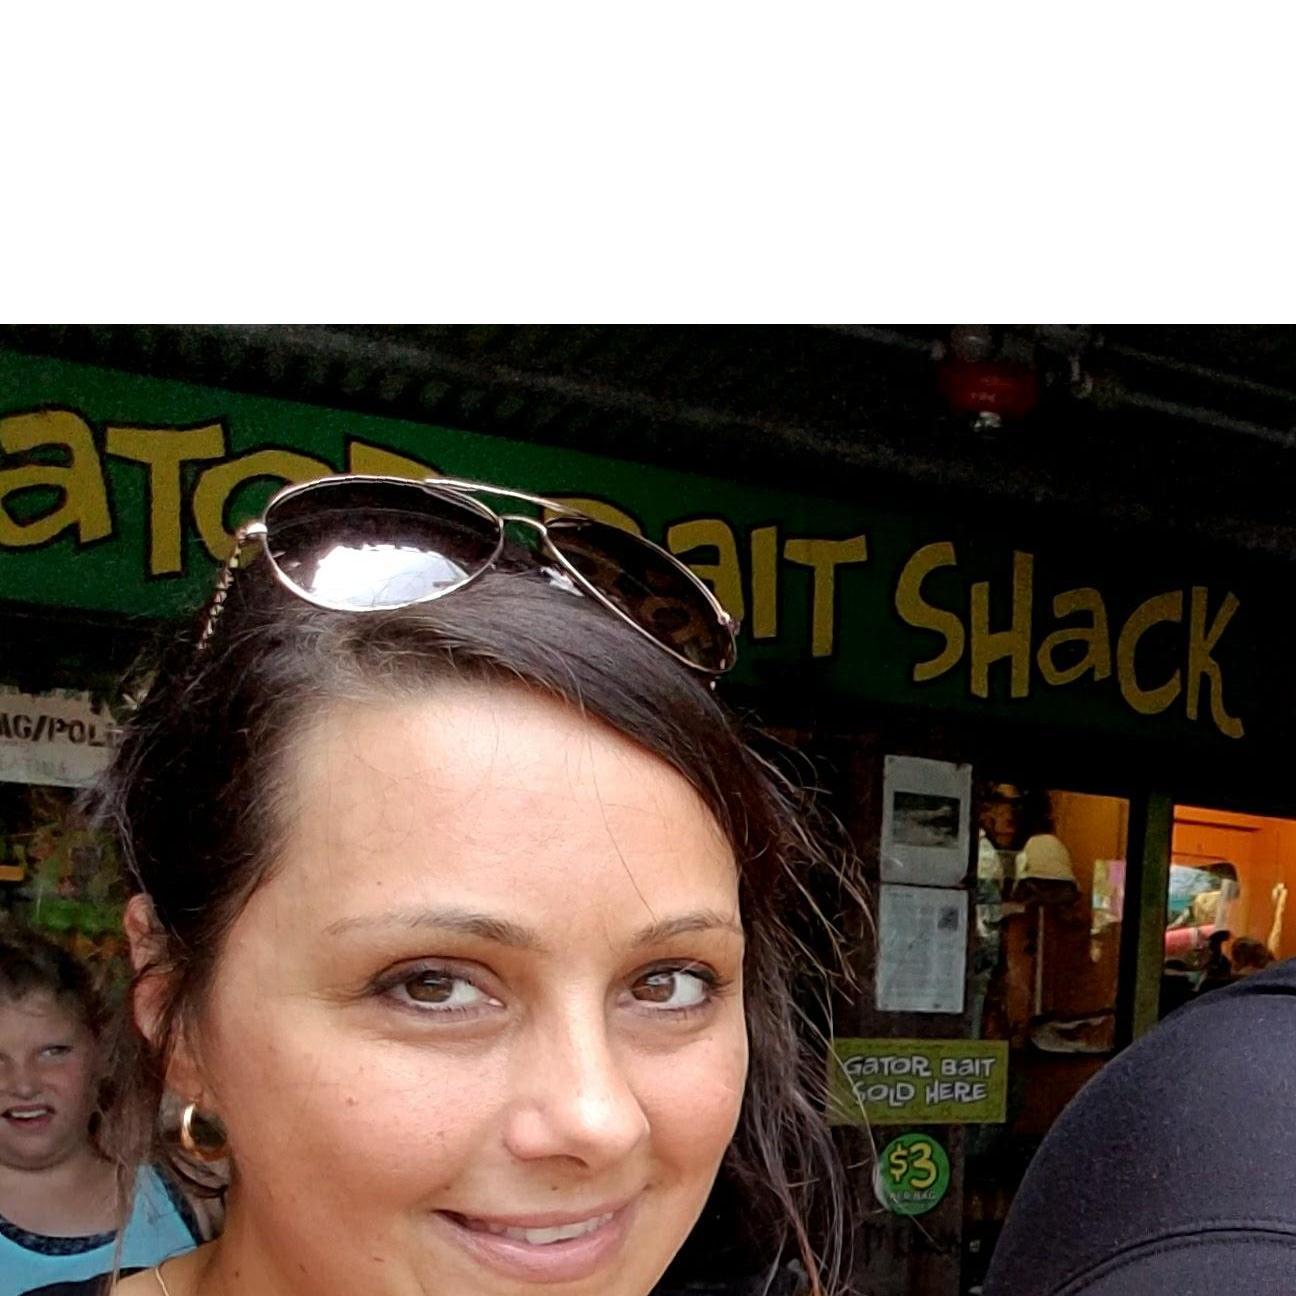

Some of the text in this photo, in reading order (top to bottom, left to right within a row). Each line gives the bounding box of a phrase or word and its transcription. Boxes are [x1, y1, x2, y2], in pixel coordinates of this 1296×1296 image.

[852, 1080, 988, 1107] SOLD HERE
[890, 1143, 937, 1188] $3
